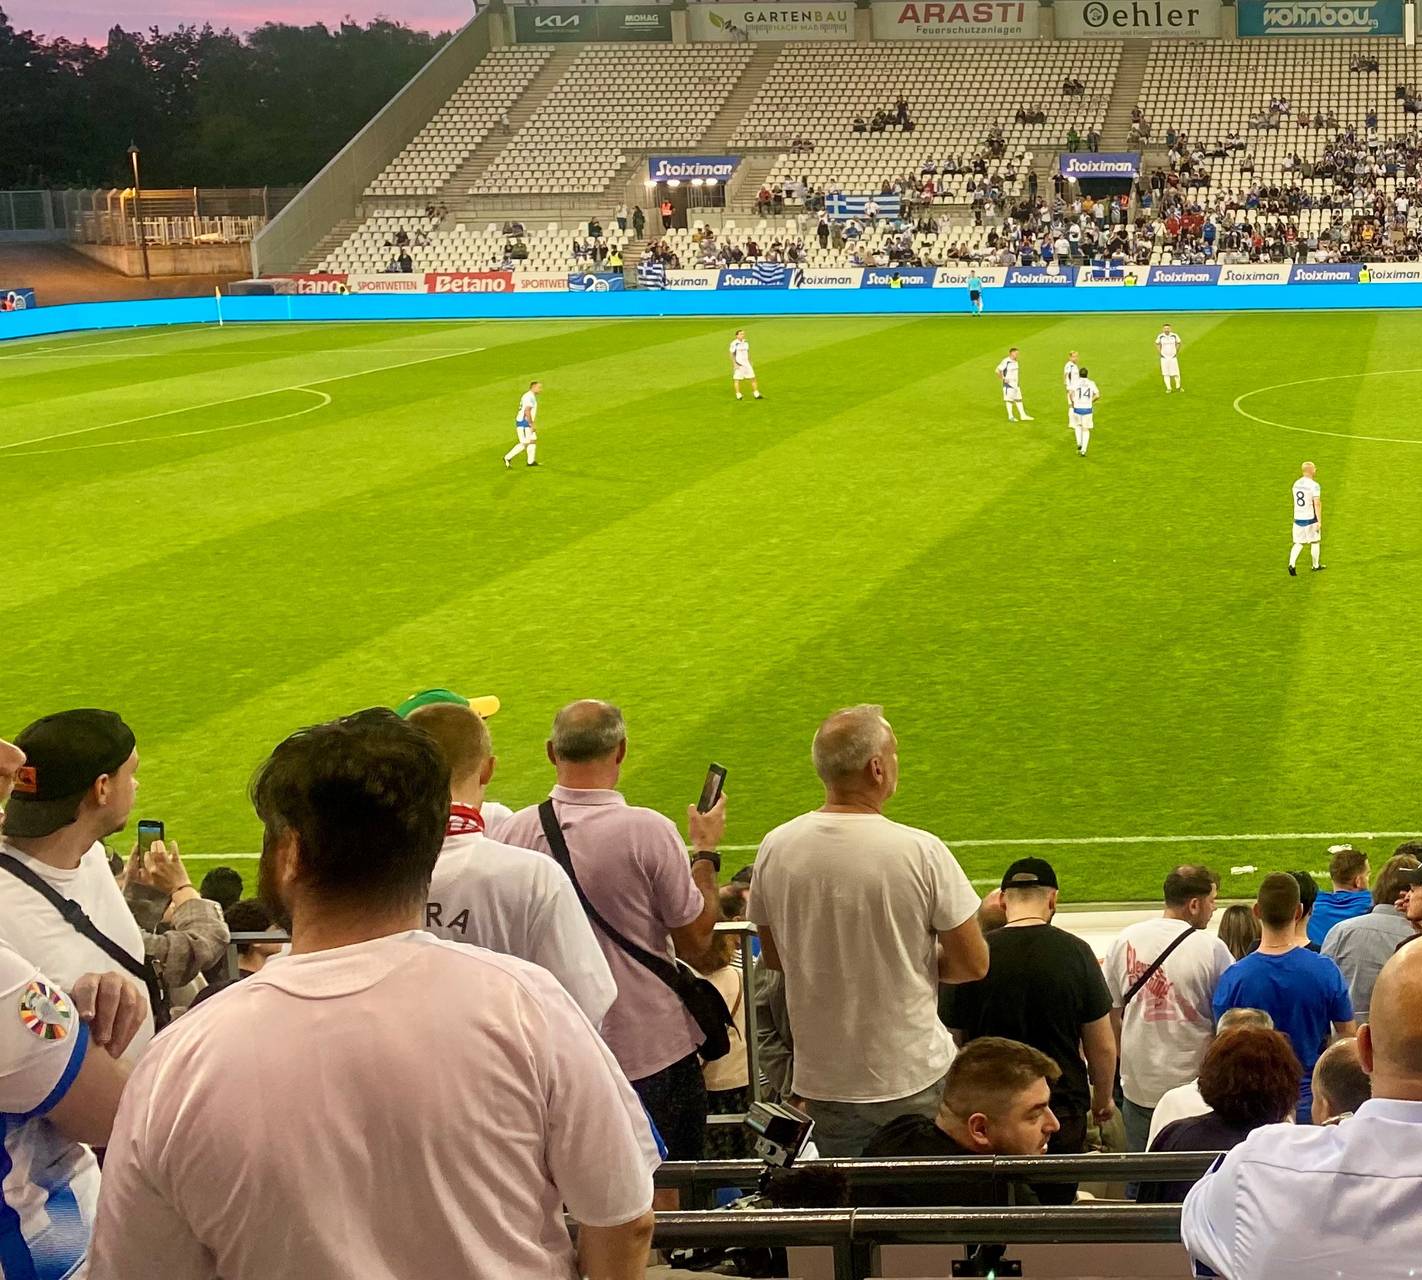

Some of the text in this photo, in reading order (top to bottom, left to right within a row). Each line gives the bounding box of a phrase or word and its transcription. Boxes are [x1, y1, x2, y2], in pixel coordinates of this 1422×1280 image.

[624, 14, 659, 22] MOHAG
[744, 11, 847, 22] GARTENBAU
[898, 3, 1024, 23] ARASTI
[1083, 1, 1199, 27] Oehler
[916, 26, 1022, 35] Feuerschutzanlagen
[656, 160, 732, 176] Stoiximan
[1066, 158, 1132, 172] Stoiximan
[1010, 272, 1067, 283] Stoiximan
[1153, 271, 1210, 282] Stoiximan
[1224, 270, 1280, 281] Stoiximan
[1294, 269, 1350, 281] Stoiximan
[357, 280, 417, 291] SPORTWETTEN
[435, 275, 506, 293] Betano
[1077, 388, 1091, 399] 14
[1296, 491, 1305, 507] 8
